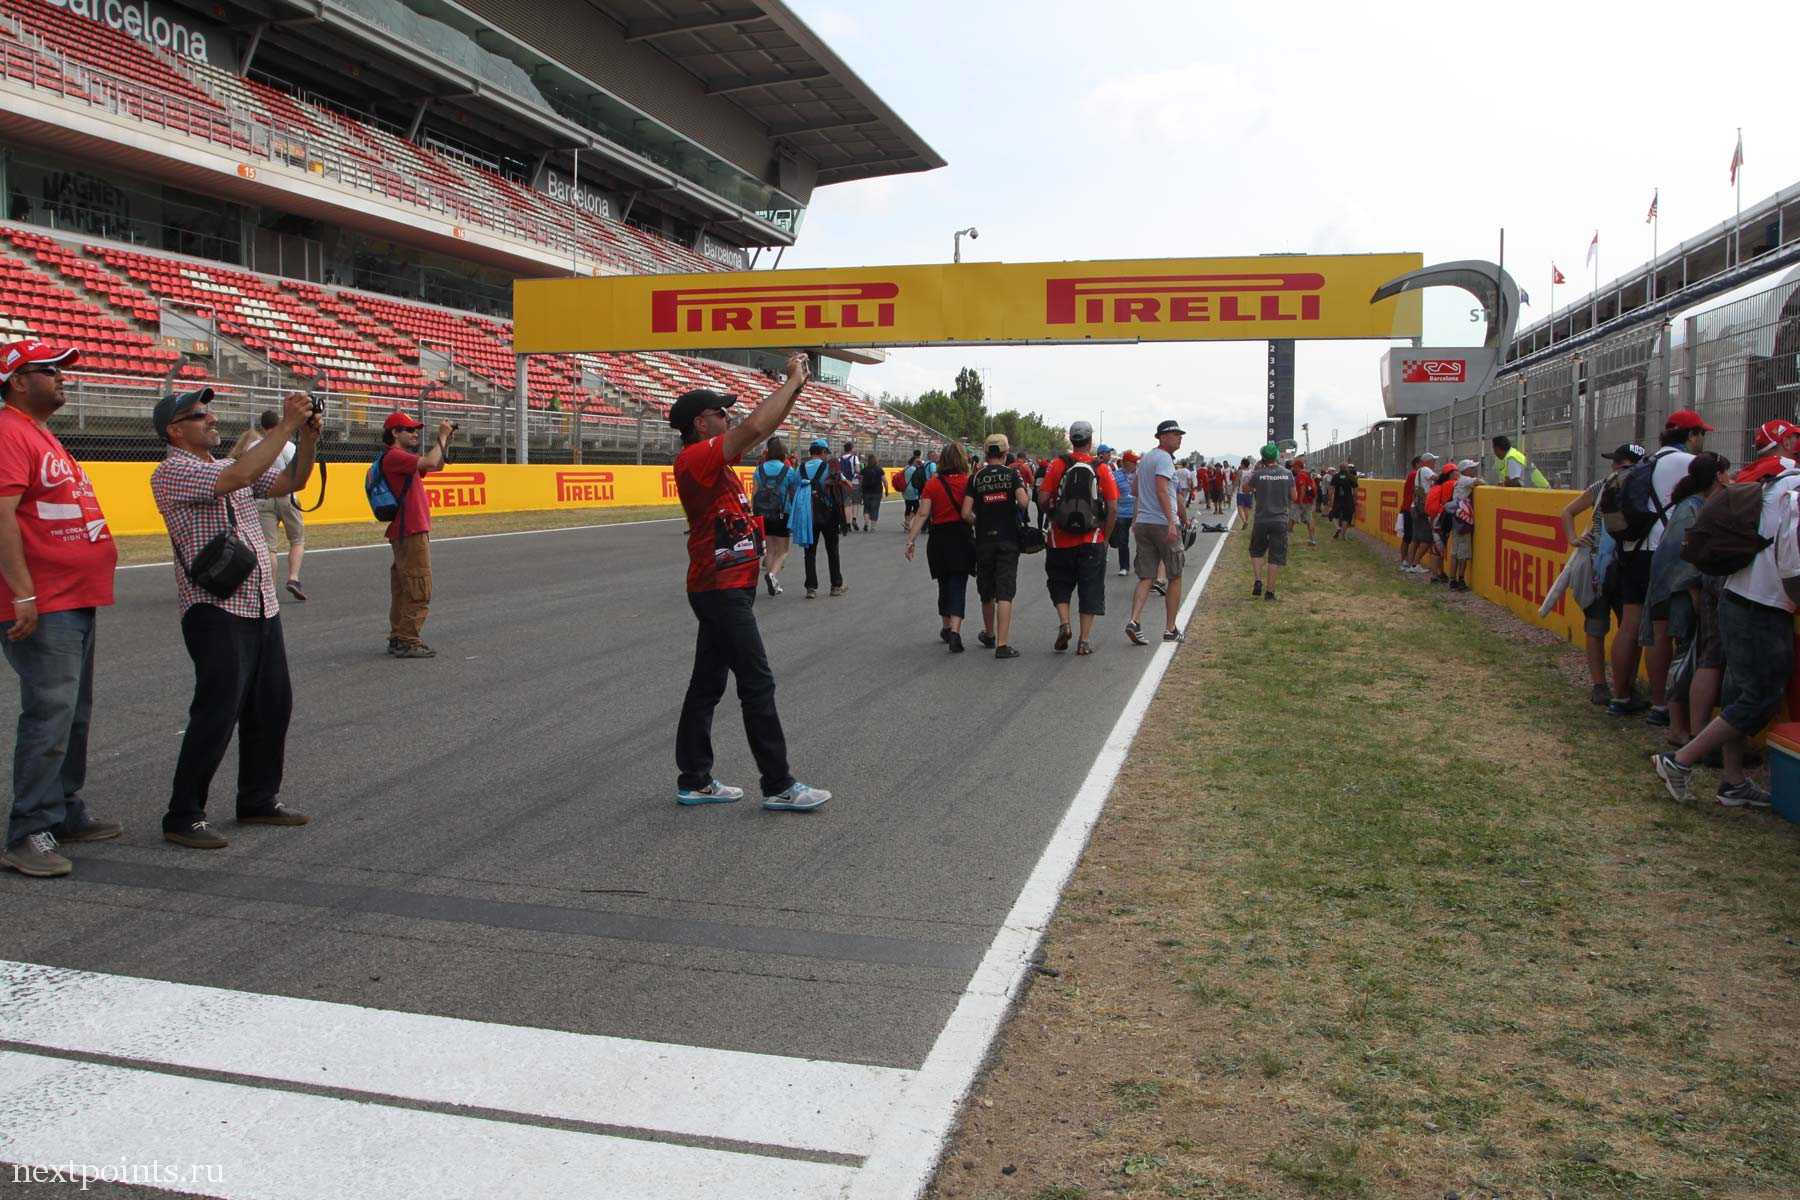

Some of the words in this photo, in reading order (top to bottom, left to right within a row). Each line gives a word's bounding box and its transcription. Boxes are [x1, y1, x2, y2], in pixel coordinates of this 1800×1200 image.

[46, 0, 208, 63] arcelona
[548, 170, 610, 218] Barcelona
[704, 236, 742, 269] Barcelona
[652, 282, 900, 333] PIRELLI
[1046, 272, 1326, 324] PIRELLI
[423, 472, 487, 508] PRELLI
[556, 472, 614, 502] PIRELLI
